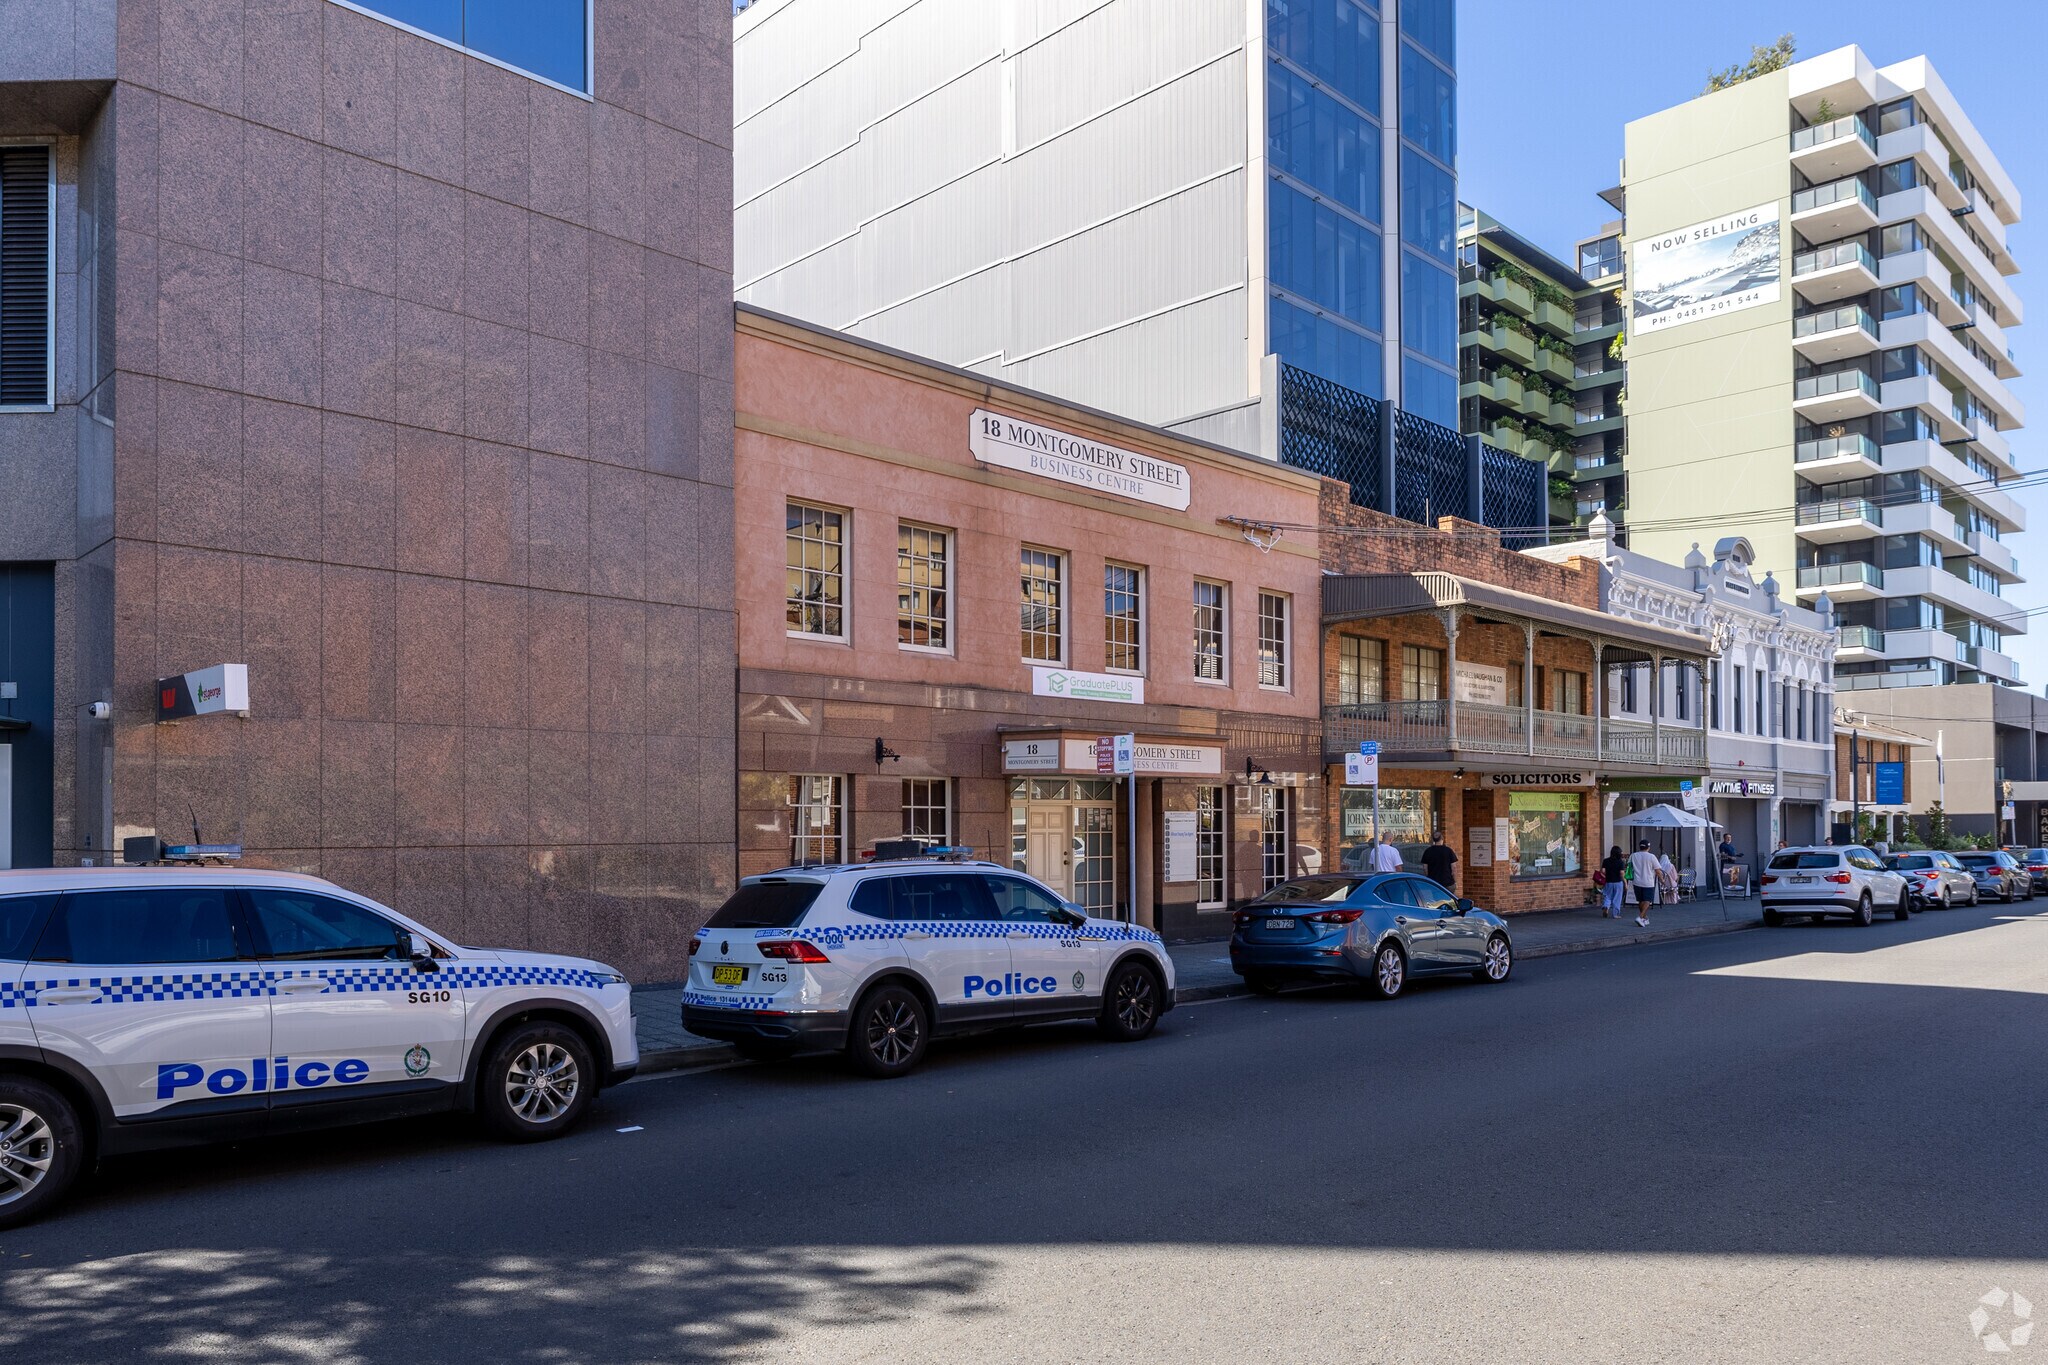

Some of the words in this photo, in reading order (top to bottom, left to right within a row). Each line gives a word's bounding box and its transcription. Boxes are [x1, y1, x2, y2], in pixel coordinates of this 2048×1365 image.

[1651, 234, 1687, 252] NOW
[1694, 214, 1759, 241] SELLING
[1652, 315, 1671, 325] PH:
[1677, 307, 1705, 319] 0481
[1711, 300, 1731, 311] 201
[1738, 293, 1759, 304] 544
[981, 417, 1001, 437] 18
[1007, 424, 1124, 470] MONTGOMERY
[1130, 457, 1182, 486] STREET
[1030, 455, 1093, 482] BUSINESS
[1097, 472, 1144, 495] CENTRE
[1070, 676, 1133, 692] GraduatePLUS
[1026, 744, 1038, 754] 18
[1170, 749, 1202, 759] STREET
[1492, 774, 1581, 784] SOLICITORS
[1712, 781, 1741, 793] ANYTIME
[1748, 783, 1774, 794] FITNESS
[825, 934, 844, 944] 000
[724, 967, 733, 980] 53
[762, 972, 787, 983] SG13
[964, 972, 1057, 998] Police
[408, 990, 450, 1004] SG10
[157, 1056, 370, 1100] Police
